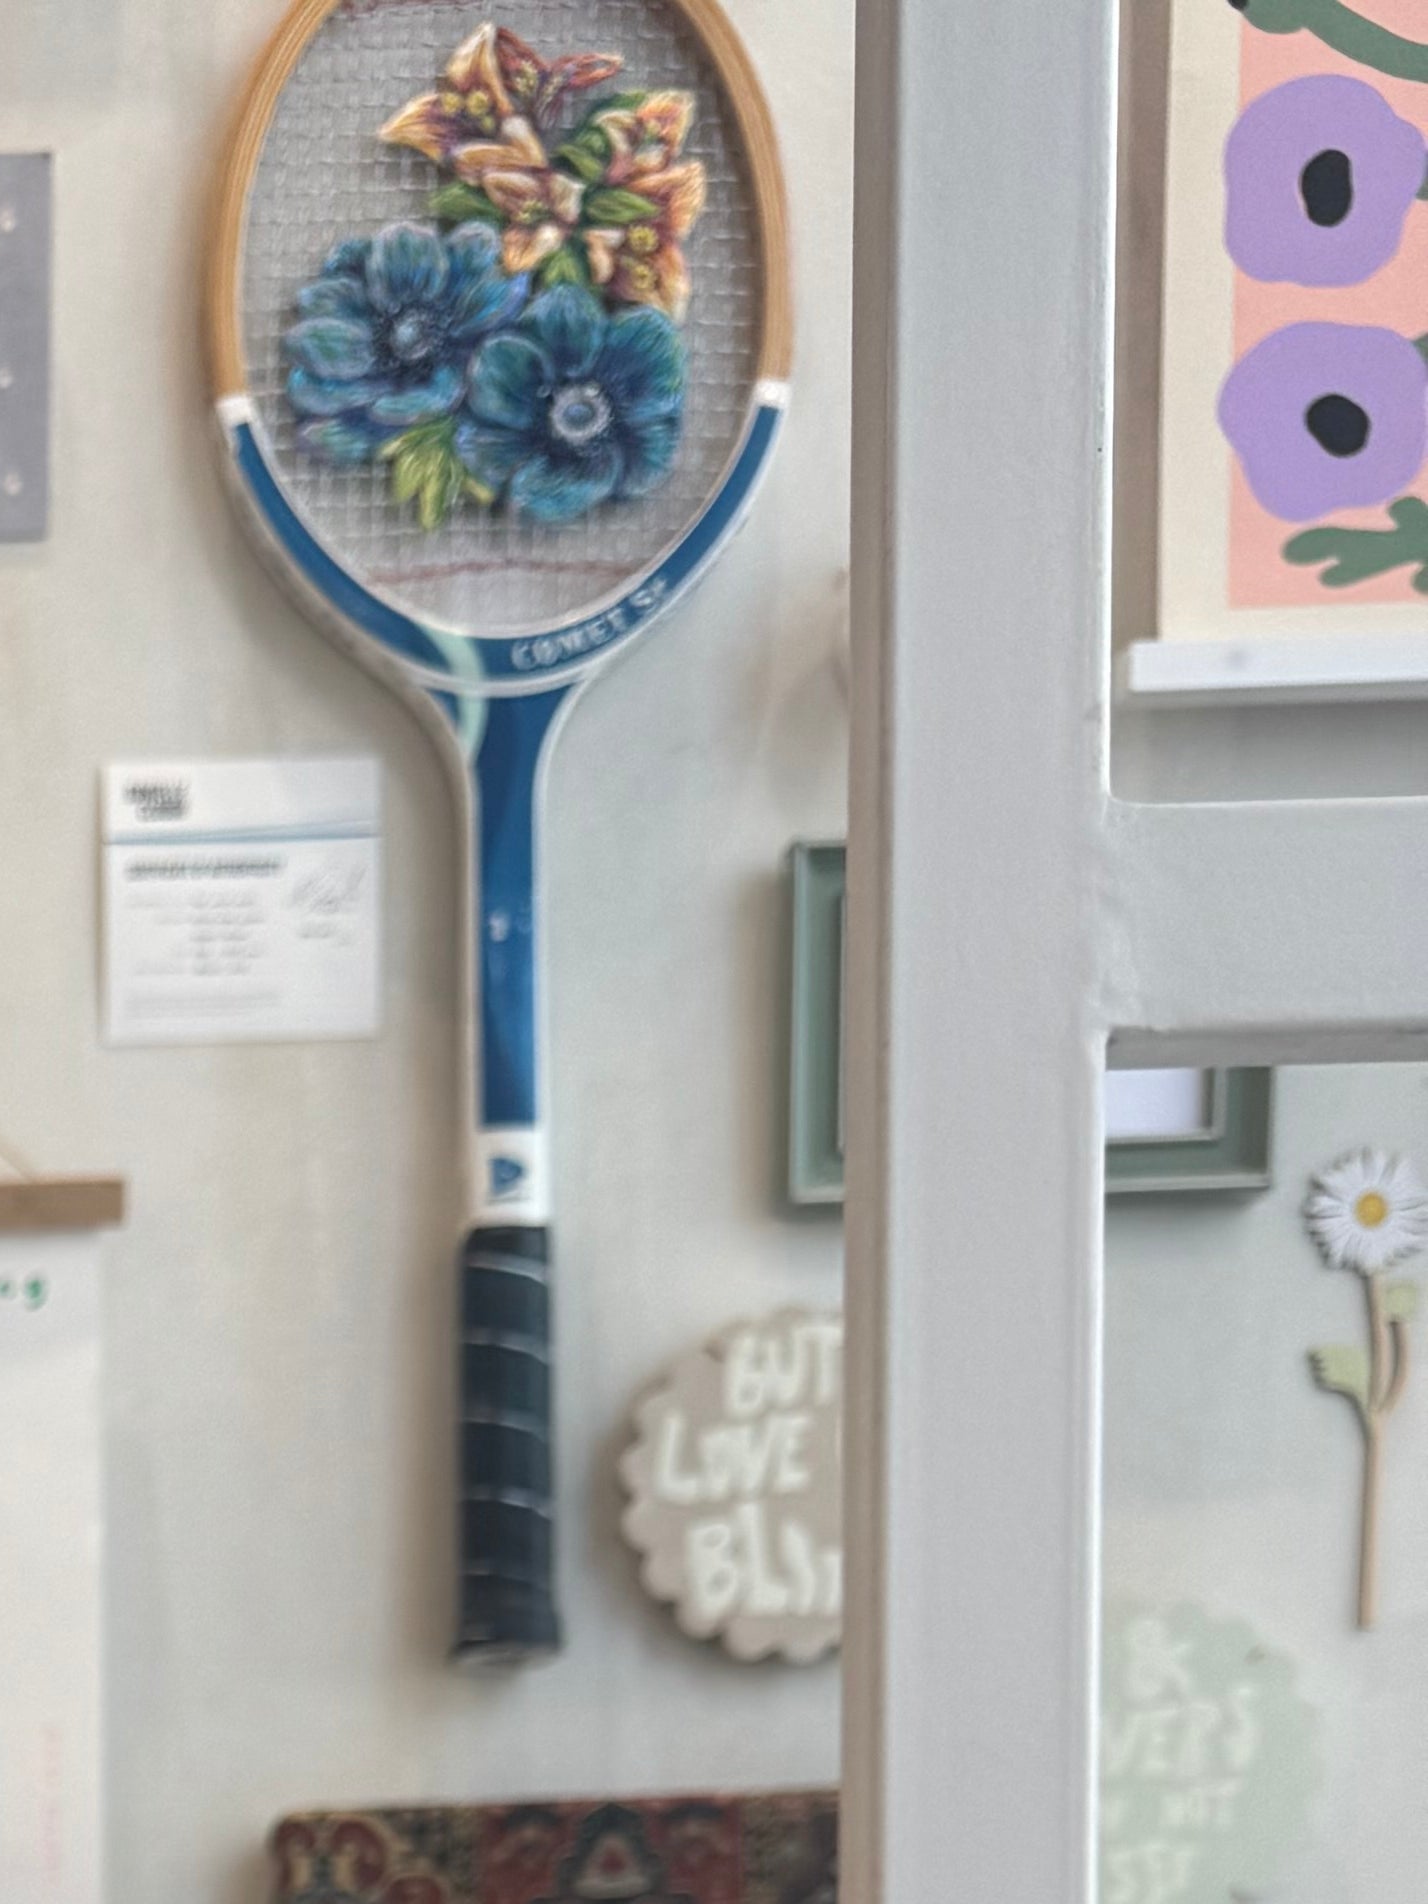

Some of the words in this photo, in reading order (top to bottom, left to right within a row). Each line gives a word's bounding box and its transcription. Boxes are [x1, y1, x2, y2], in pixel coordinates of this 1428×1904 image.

[510, 607, 626, 671] COMET
[726, 1325, 842, 1414] BUT
[656, 1410, 809, 1498] LOVE
